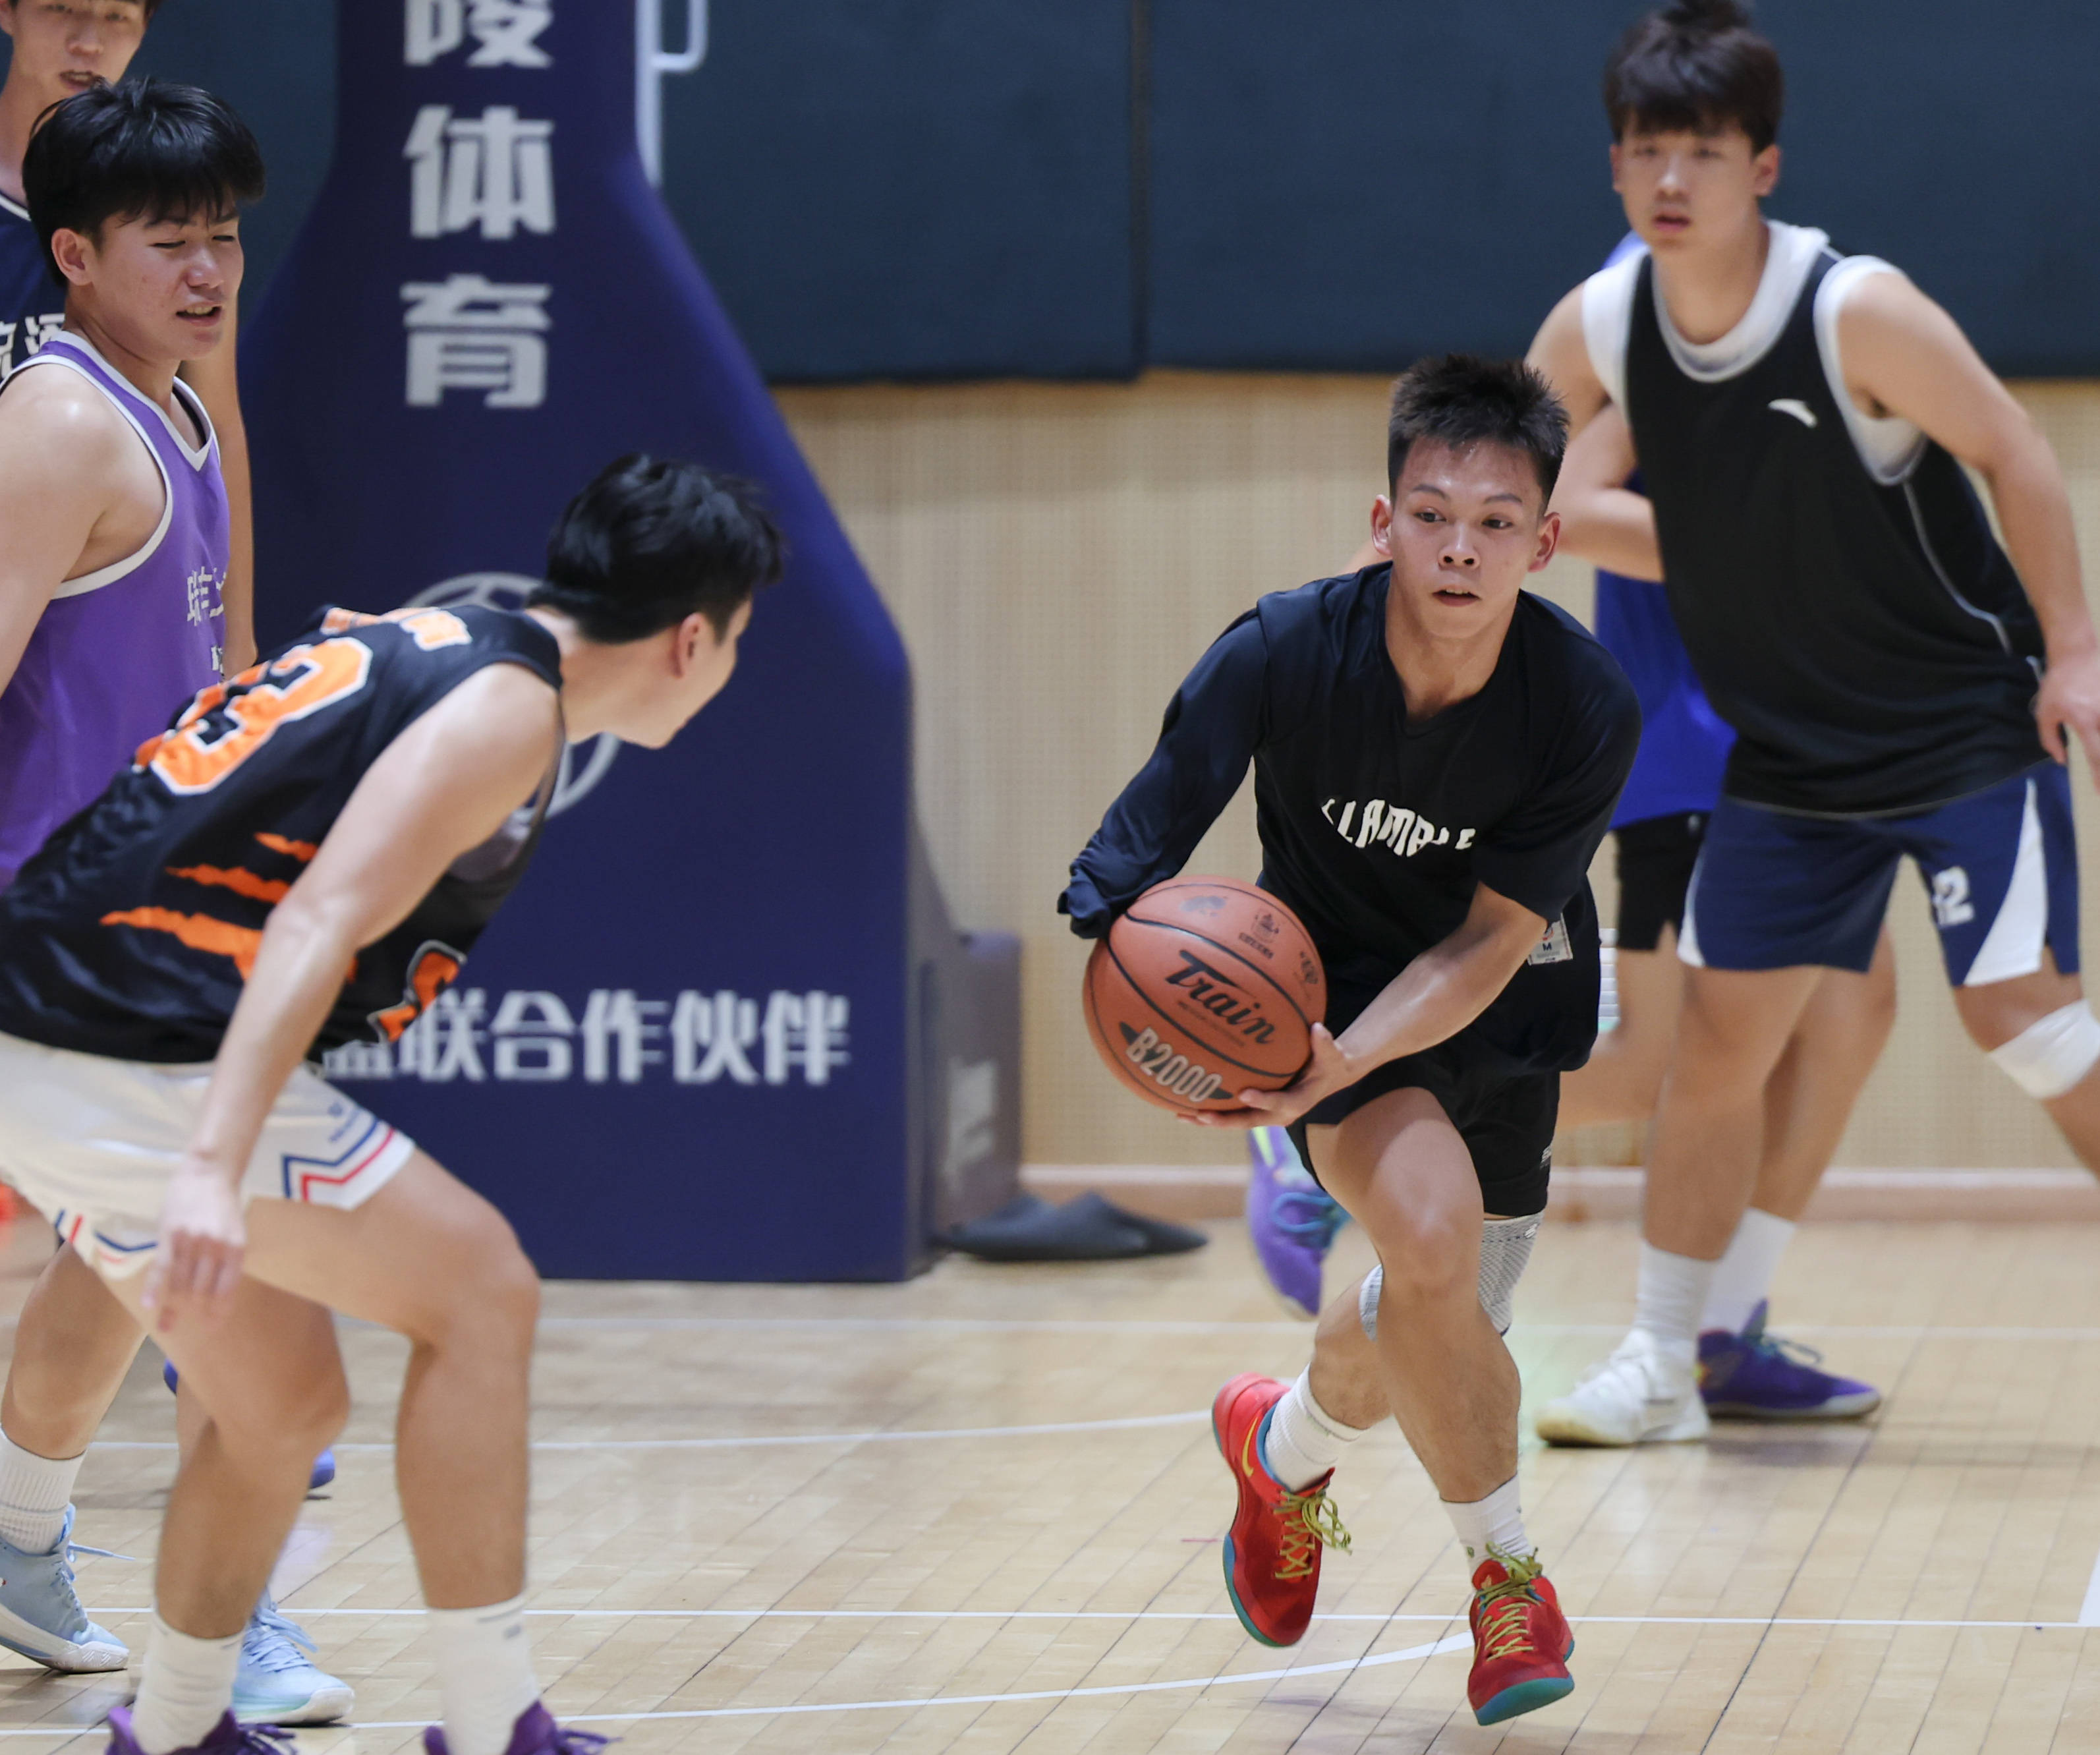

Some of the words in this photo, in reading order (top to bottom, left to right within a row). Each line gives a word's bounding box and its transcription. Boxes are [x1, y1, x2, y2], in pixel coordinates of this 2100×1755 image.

[1543, 942, 1552, 951] M
[1164, 949, 1275, 1045] Train
[1125, 1026, 1223, 1103] B2000
